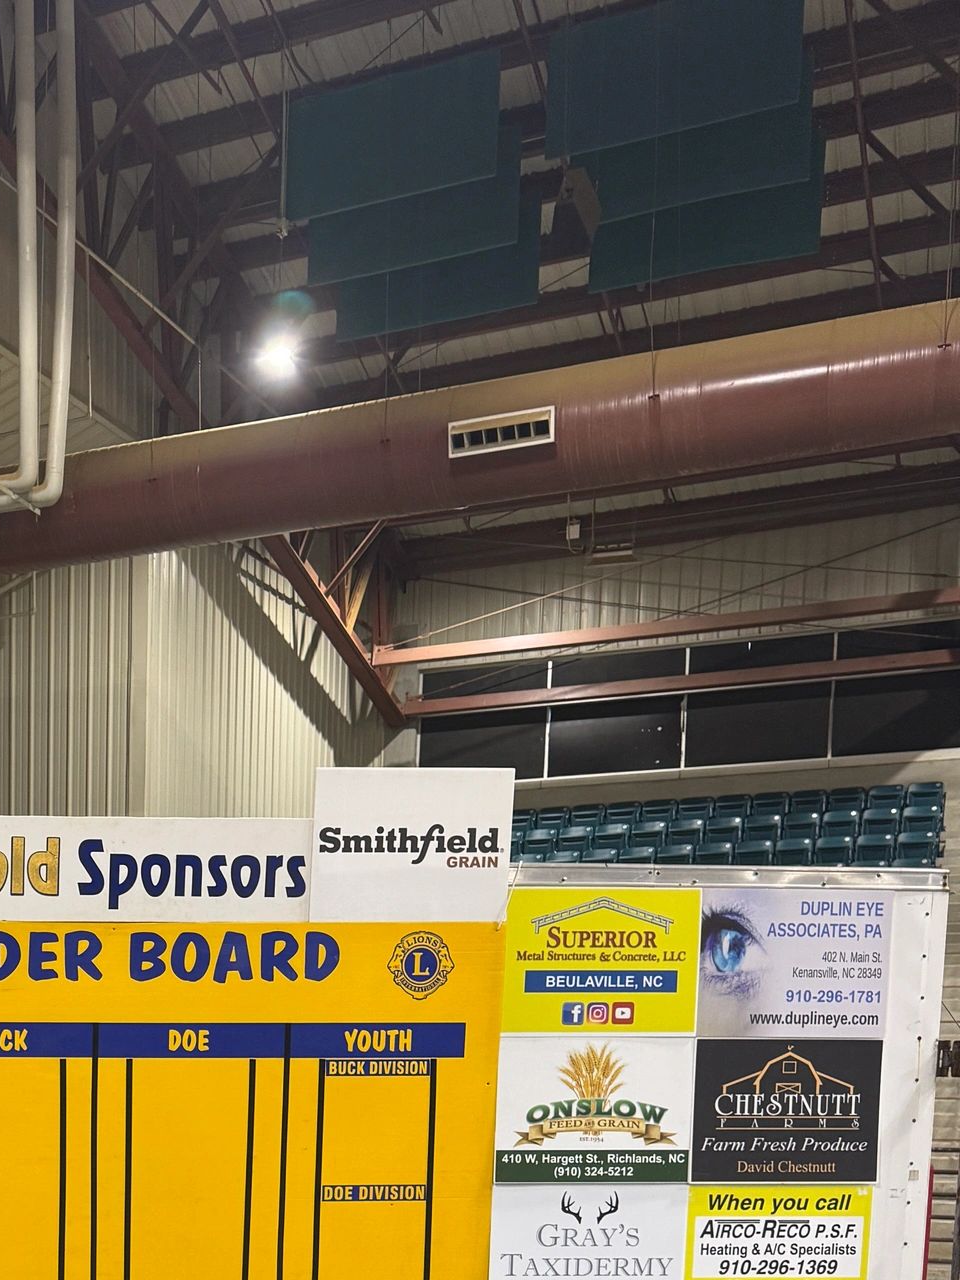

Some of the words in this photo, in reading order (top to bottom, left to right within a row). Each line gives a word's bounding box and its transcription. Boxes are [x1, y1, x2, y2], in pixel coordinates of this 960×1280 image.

[447, 857, 498, 868] GRAIN
[78, 839, 306, 909] Sponsors
[801, 901, 851, 916] DUPLIN
[856, 903, 884, 916] EYE
[547, 926, 657, 948] SUPERIOR
[767, 923, 860, 941] ASSOCIATES,
[864, 924, 882, 938] PA
[406, 936, 438, 947] LIONS
[130, 931, 340, 983] BOARD
[517, 951, 544, 961] Metal
[547, 951, 595, 961] Structures
[600, 953, 610, 962] &
[613, 952, 659, 962] Concrete,
[663, 952, 686, 961] LLC
[822, 952, 837, 962] 402
[839, 952, 848, 962] N.
[850, 952, 869, 962] Main
[872, 952, 882, 963] St.
[792, 967, 840, 980] Kenansville,
[842, 968, 855, 978] NC
[857, 968, 882, 978] 28349
[546, 976, 638, 989] BEULAVILLE,
[643, 976, 663, 988] NC
[786, 990, 881, 1003] 910-296-1781
[750, 1012, 879, 1028] www.duplineye.com
[168, 1029, 210, 1052] DOE
[344, 1029, 412, 1052] YOUTH
[328, 1061, 365, 1075] BUCK
[369, 1061, 427, 1075] DIVISION
[526, 1099, 668, 1124] ONSLOW
[715, 1093, 861, 1116] CHESTNUTT
[701, 1137, 745, 1152] Farm
[751, 1137, 796, 1152] Fresh
[802, 1137, 868, 1152] Produce
[502, 1154, 521, 1164] 410
[542, 1154, 583, 1166] Hargett
[607, 1154, 665, 1165] Richlands,
[668, 1154, 685, 1164] NC
[737, 1161, 774, 1173] David
[778, 1161, 836, 1173] Chestnutt
[554, 1167, 581, 1178] (910)
[585, 1167, 633, 1176] 324-5212
[323, 1186, 353, 1200] DOE
[359, 1186, 425, 1200] DIVISION
